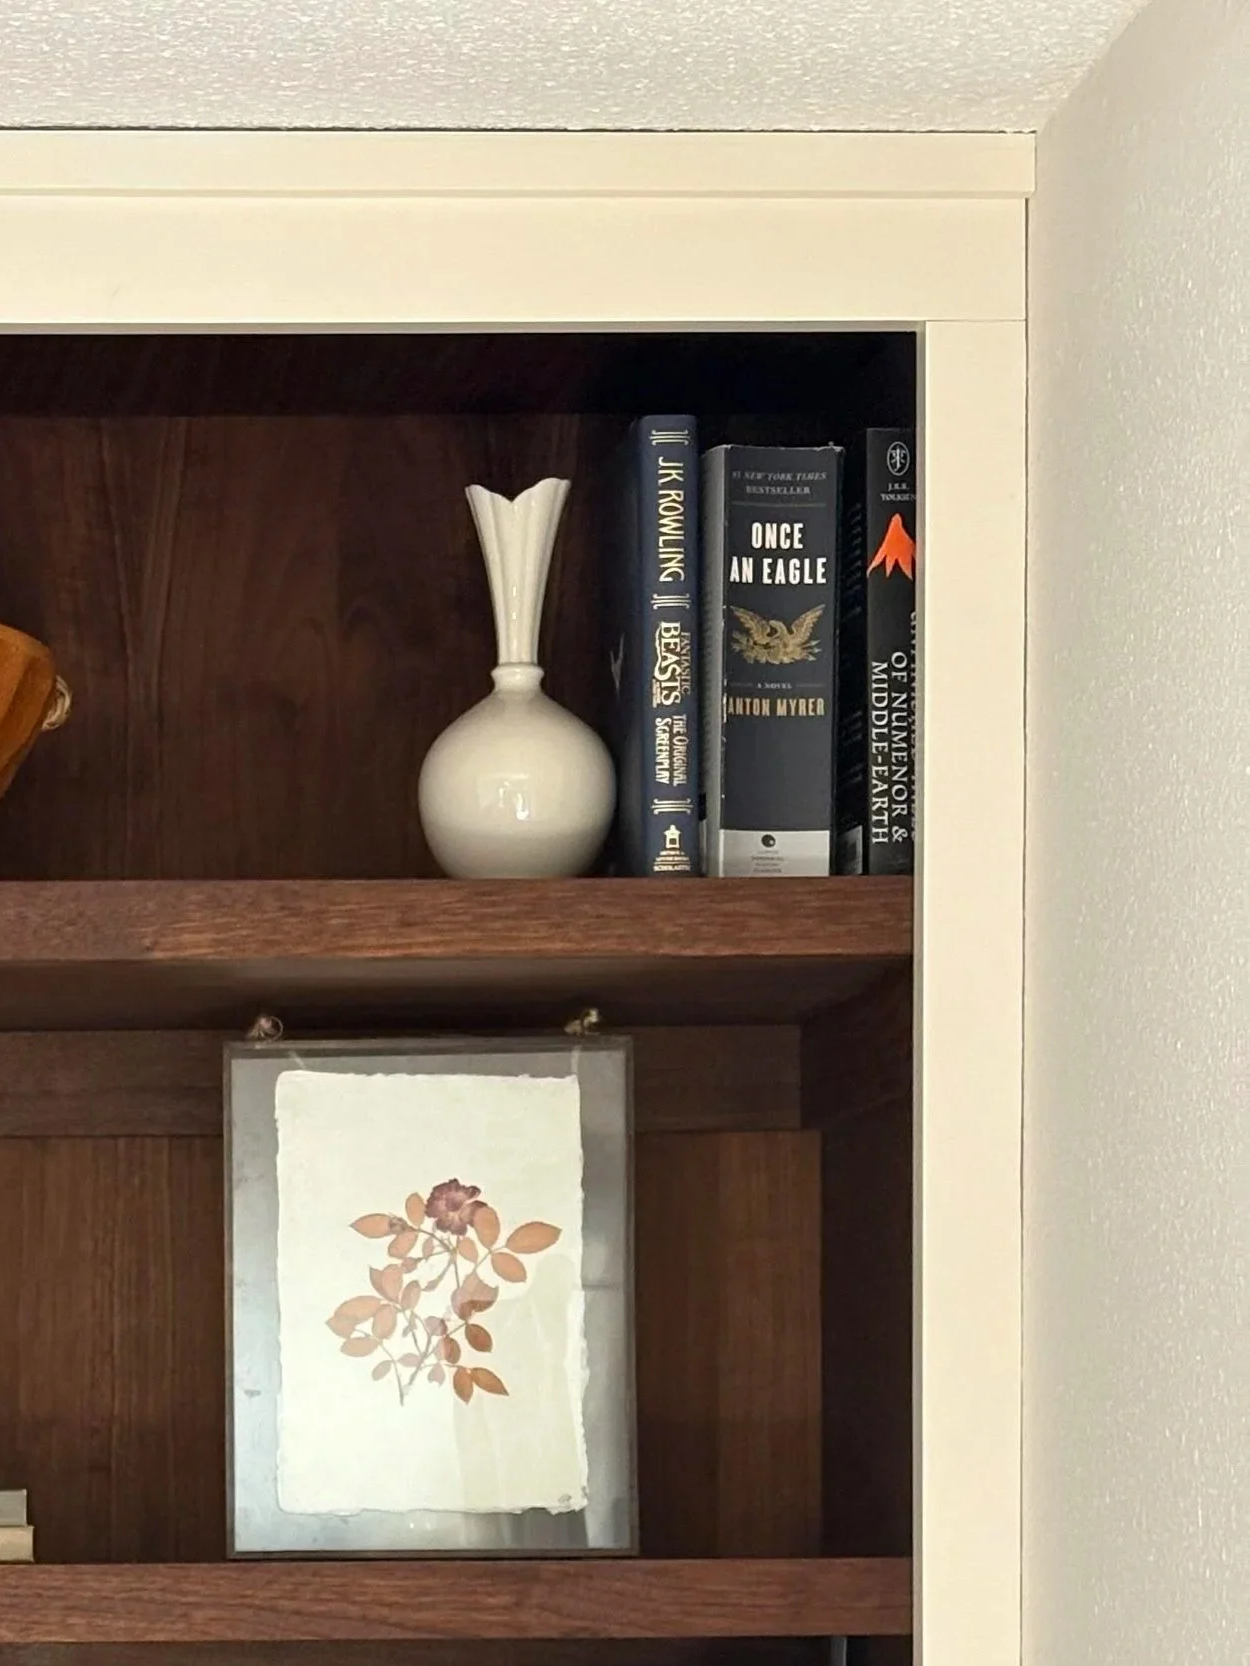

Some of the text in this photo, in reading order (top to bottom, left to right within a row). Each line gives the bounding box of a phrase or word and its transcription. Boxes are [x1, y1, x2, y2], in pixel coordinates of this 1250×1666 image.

[743, 471, 765, 480] NEW
[768, 472, 794, 481] YORK
[796, 471, 827, 480] TIMES
[746, 486, 810, 494] BESTSELLER
[658, 489, 685, 582] ROWLING
[751, 522, 804, 549] ONCE
[730, 556, 827, 584] AN EAGLE
[654, 621, 682, 706] BEASTS
[681, 631, 691, 695] FANTASTIC
[891, 652, 908, 683] OF
[728, 697, 825, 717] ANTON MYRER
[655, 717, 672, 784] SCREENPLAY
[672, 714, 689, 787] THE ORIGINAL
[871, 661, 889, 844] MIDDLE-EARTH
[891, 826, 908, 842] &
